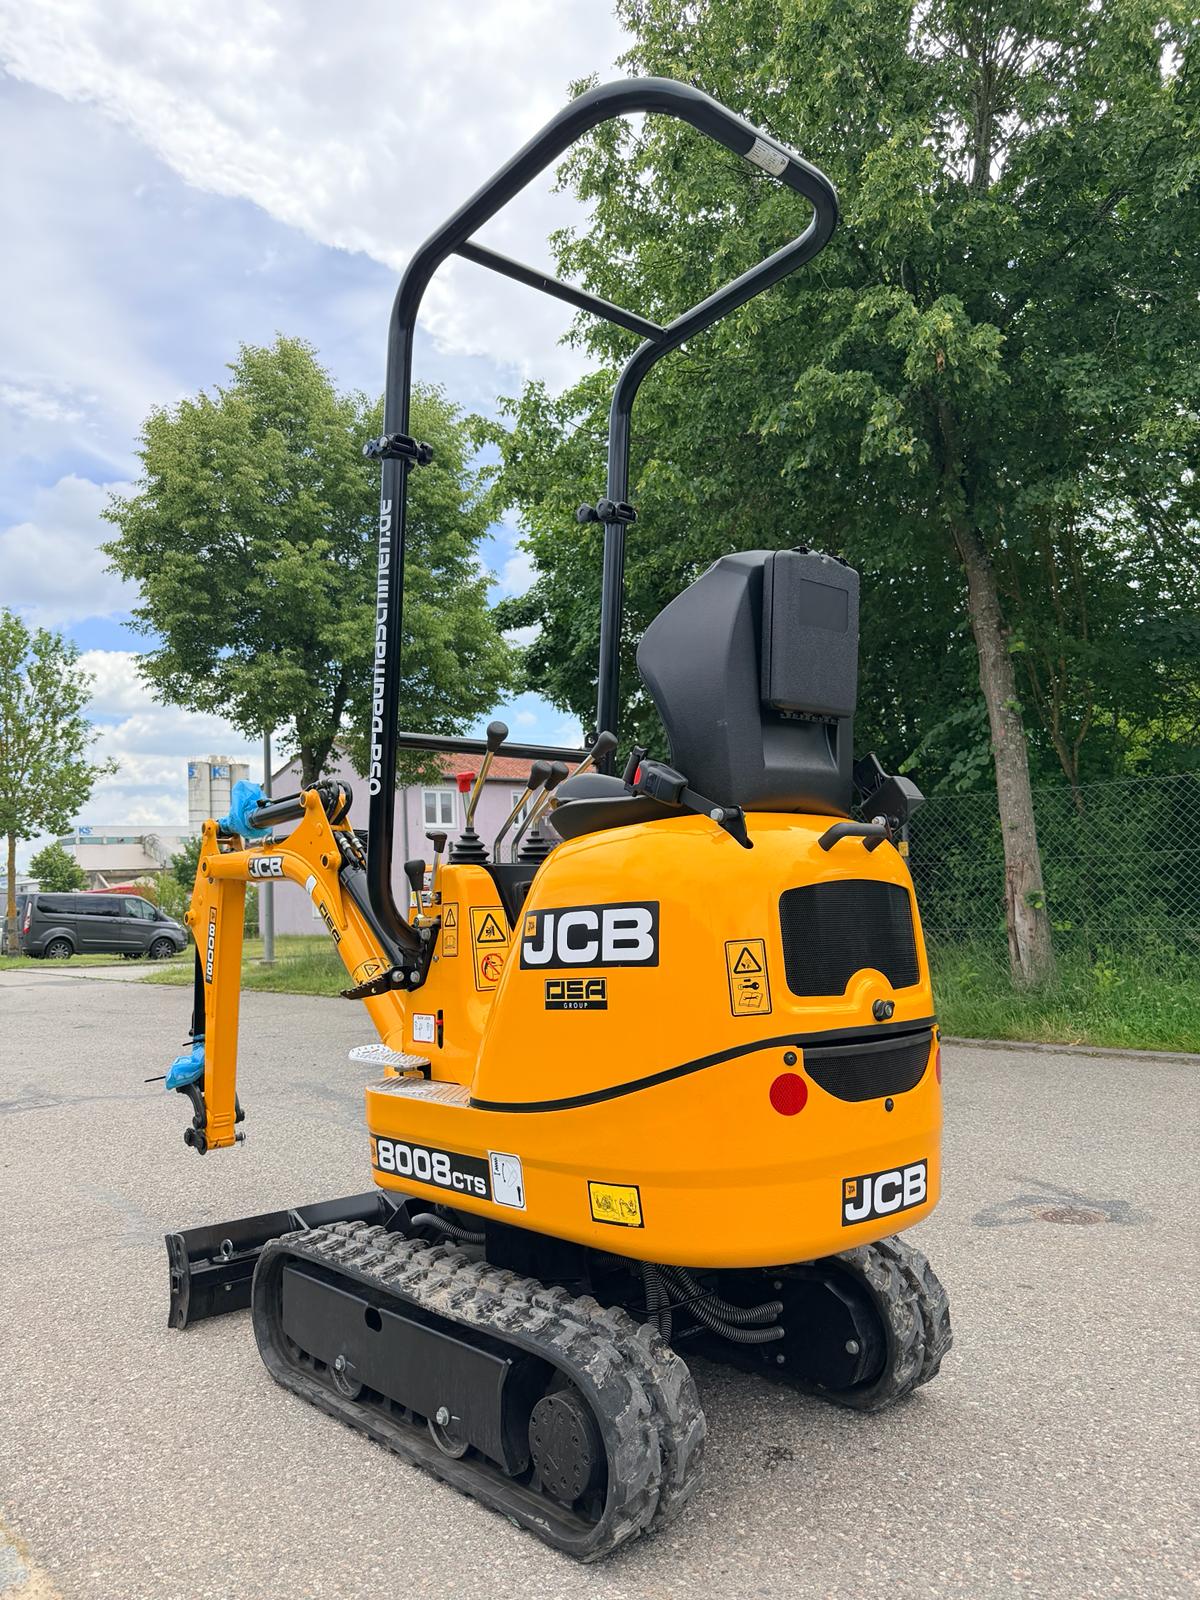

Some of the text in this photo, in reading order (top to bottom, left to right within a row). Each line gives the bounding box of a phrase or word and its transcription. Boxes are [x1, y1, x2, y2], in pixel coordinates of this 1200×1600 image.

[249, 857, 284, 878] JCB
[206, 923, 216, 976] 8008
[523, 907, 655, 964] JCB
[845, 1163, 927, 1221] JCB
